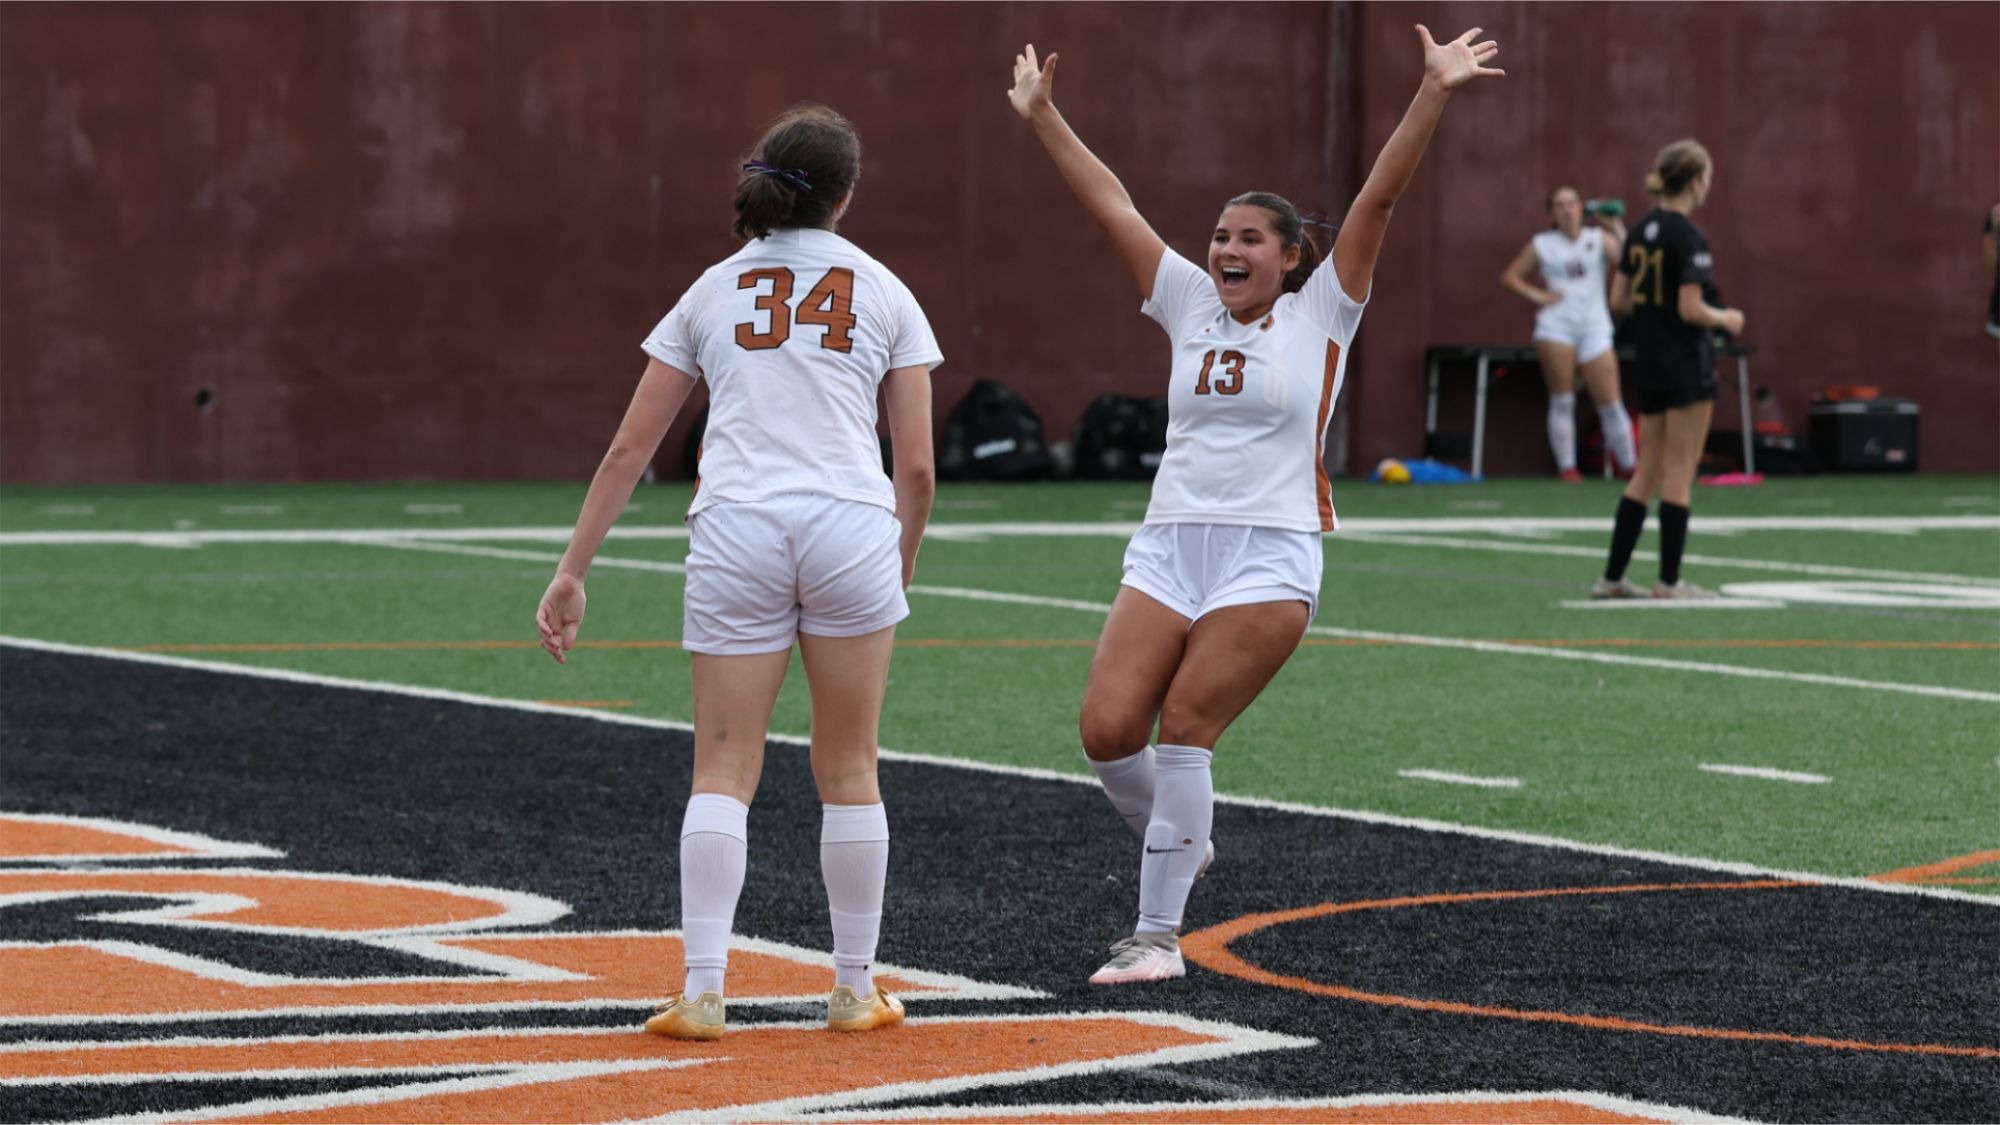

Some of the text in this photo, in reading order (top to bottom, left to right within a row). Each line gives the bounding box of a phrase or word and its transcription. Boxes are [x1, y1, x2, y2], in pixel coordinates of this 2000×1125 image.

[1628, 243, 1665, 306] 21
[735, 266, 857, 355] 34
[1194, 349, 1247, 396] 13
